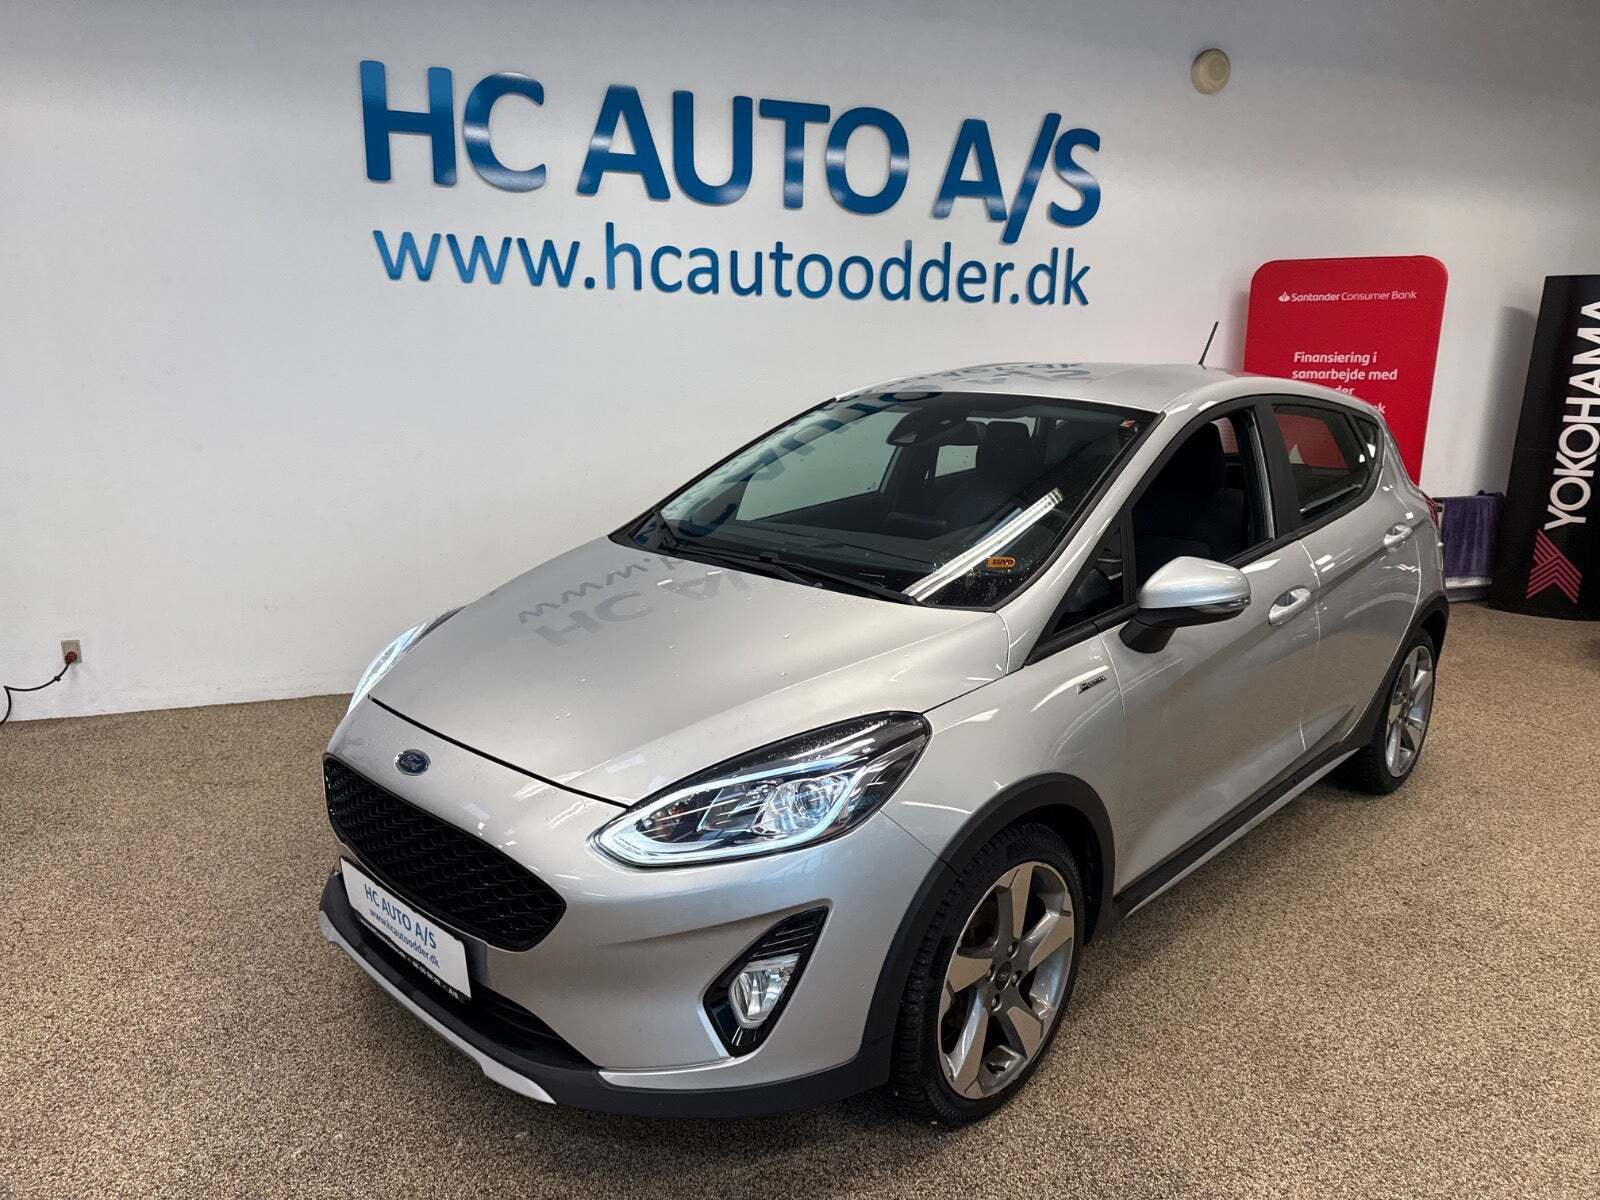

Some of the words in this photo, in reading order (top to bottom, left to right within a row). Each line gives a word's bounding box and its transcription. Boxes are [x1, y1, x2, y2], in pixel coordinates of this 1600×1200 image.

[359, 60, 547, 192] HC
[576, 84, 910, 215] AUTO
[932, 112, 1103, 245] A/S
[372, 222, 1091, 307] www.hcautoodder.dk
[1291, 293, 1340, 302] Santander
[1341, 291, 1390, 301] Consumer
[1391, 290, 1417, 300] Bank
[1291, 368, 1366, 381] samarbejde
[1368, 368, 1398, 380] med
[1293, 351, 1370, 366] Finansiering
[1372, 351, 1378, 363] i
[364, 883, 381, 908] HC
[381, 896, 413, 932] AUTO
[415, 922, 438, 951] A/S
